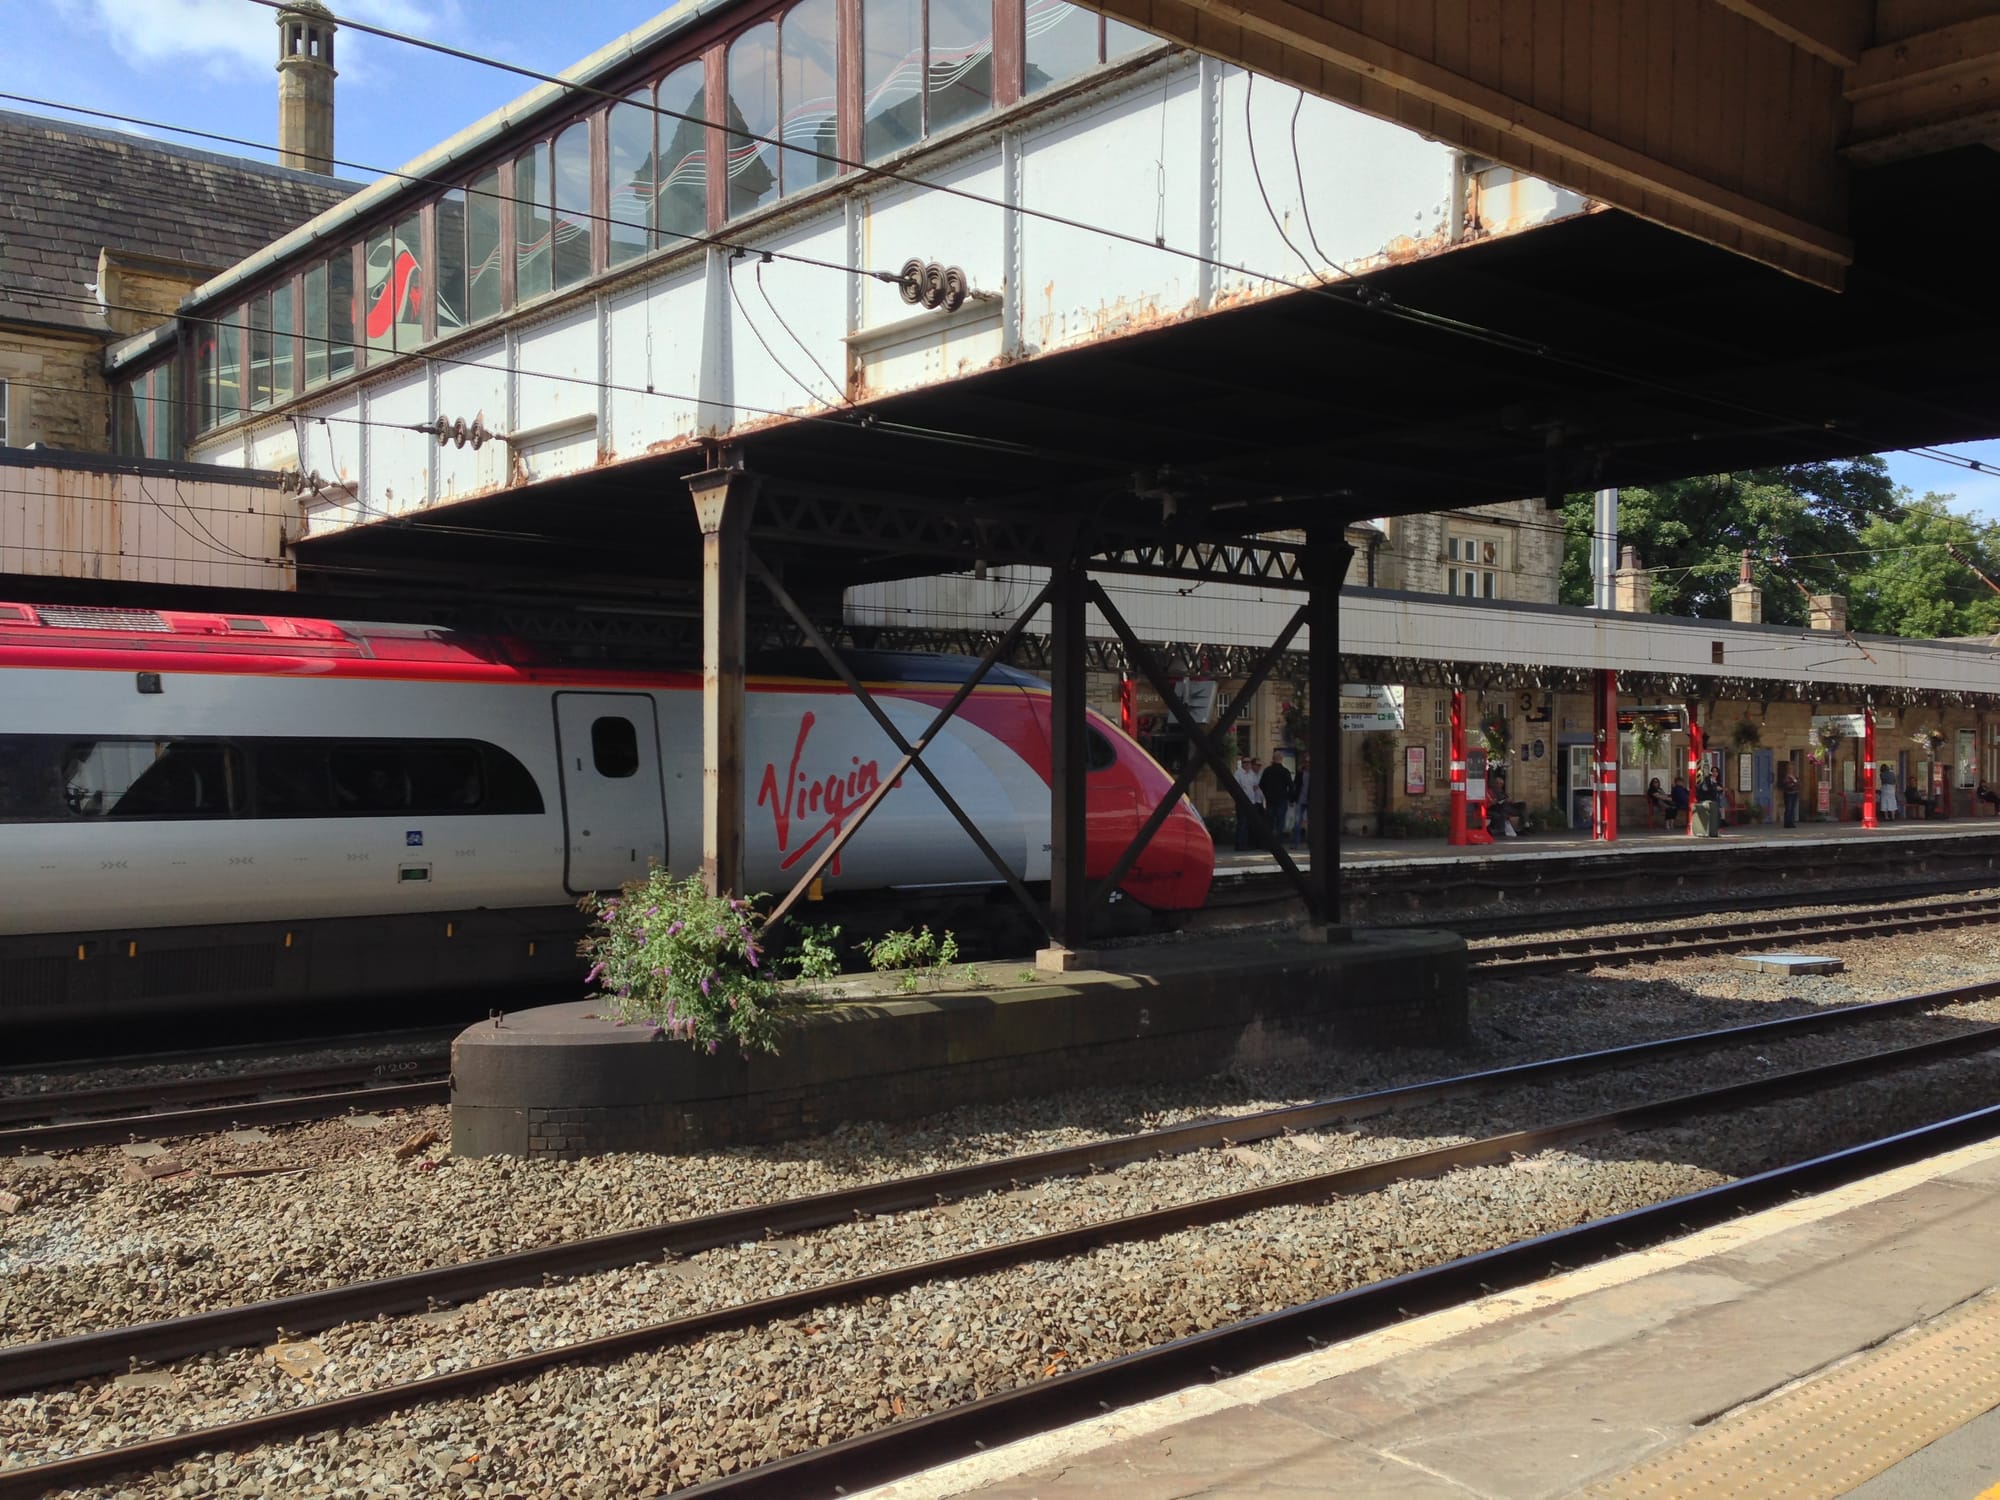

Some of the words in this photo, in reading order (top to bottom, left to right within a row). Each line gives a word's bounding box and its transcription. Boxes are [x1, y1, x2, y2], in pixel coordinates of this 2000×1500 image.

[1520, 692, 1532, 711] 3
[757, 711, 902, 877] Virgin
[1140, 1008, 1150, 1025] 2
